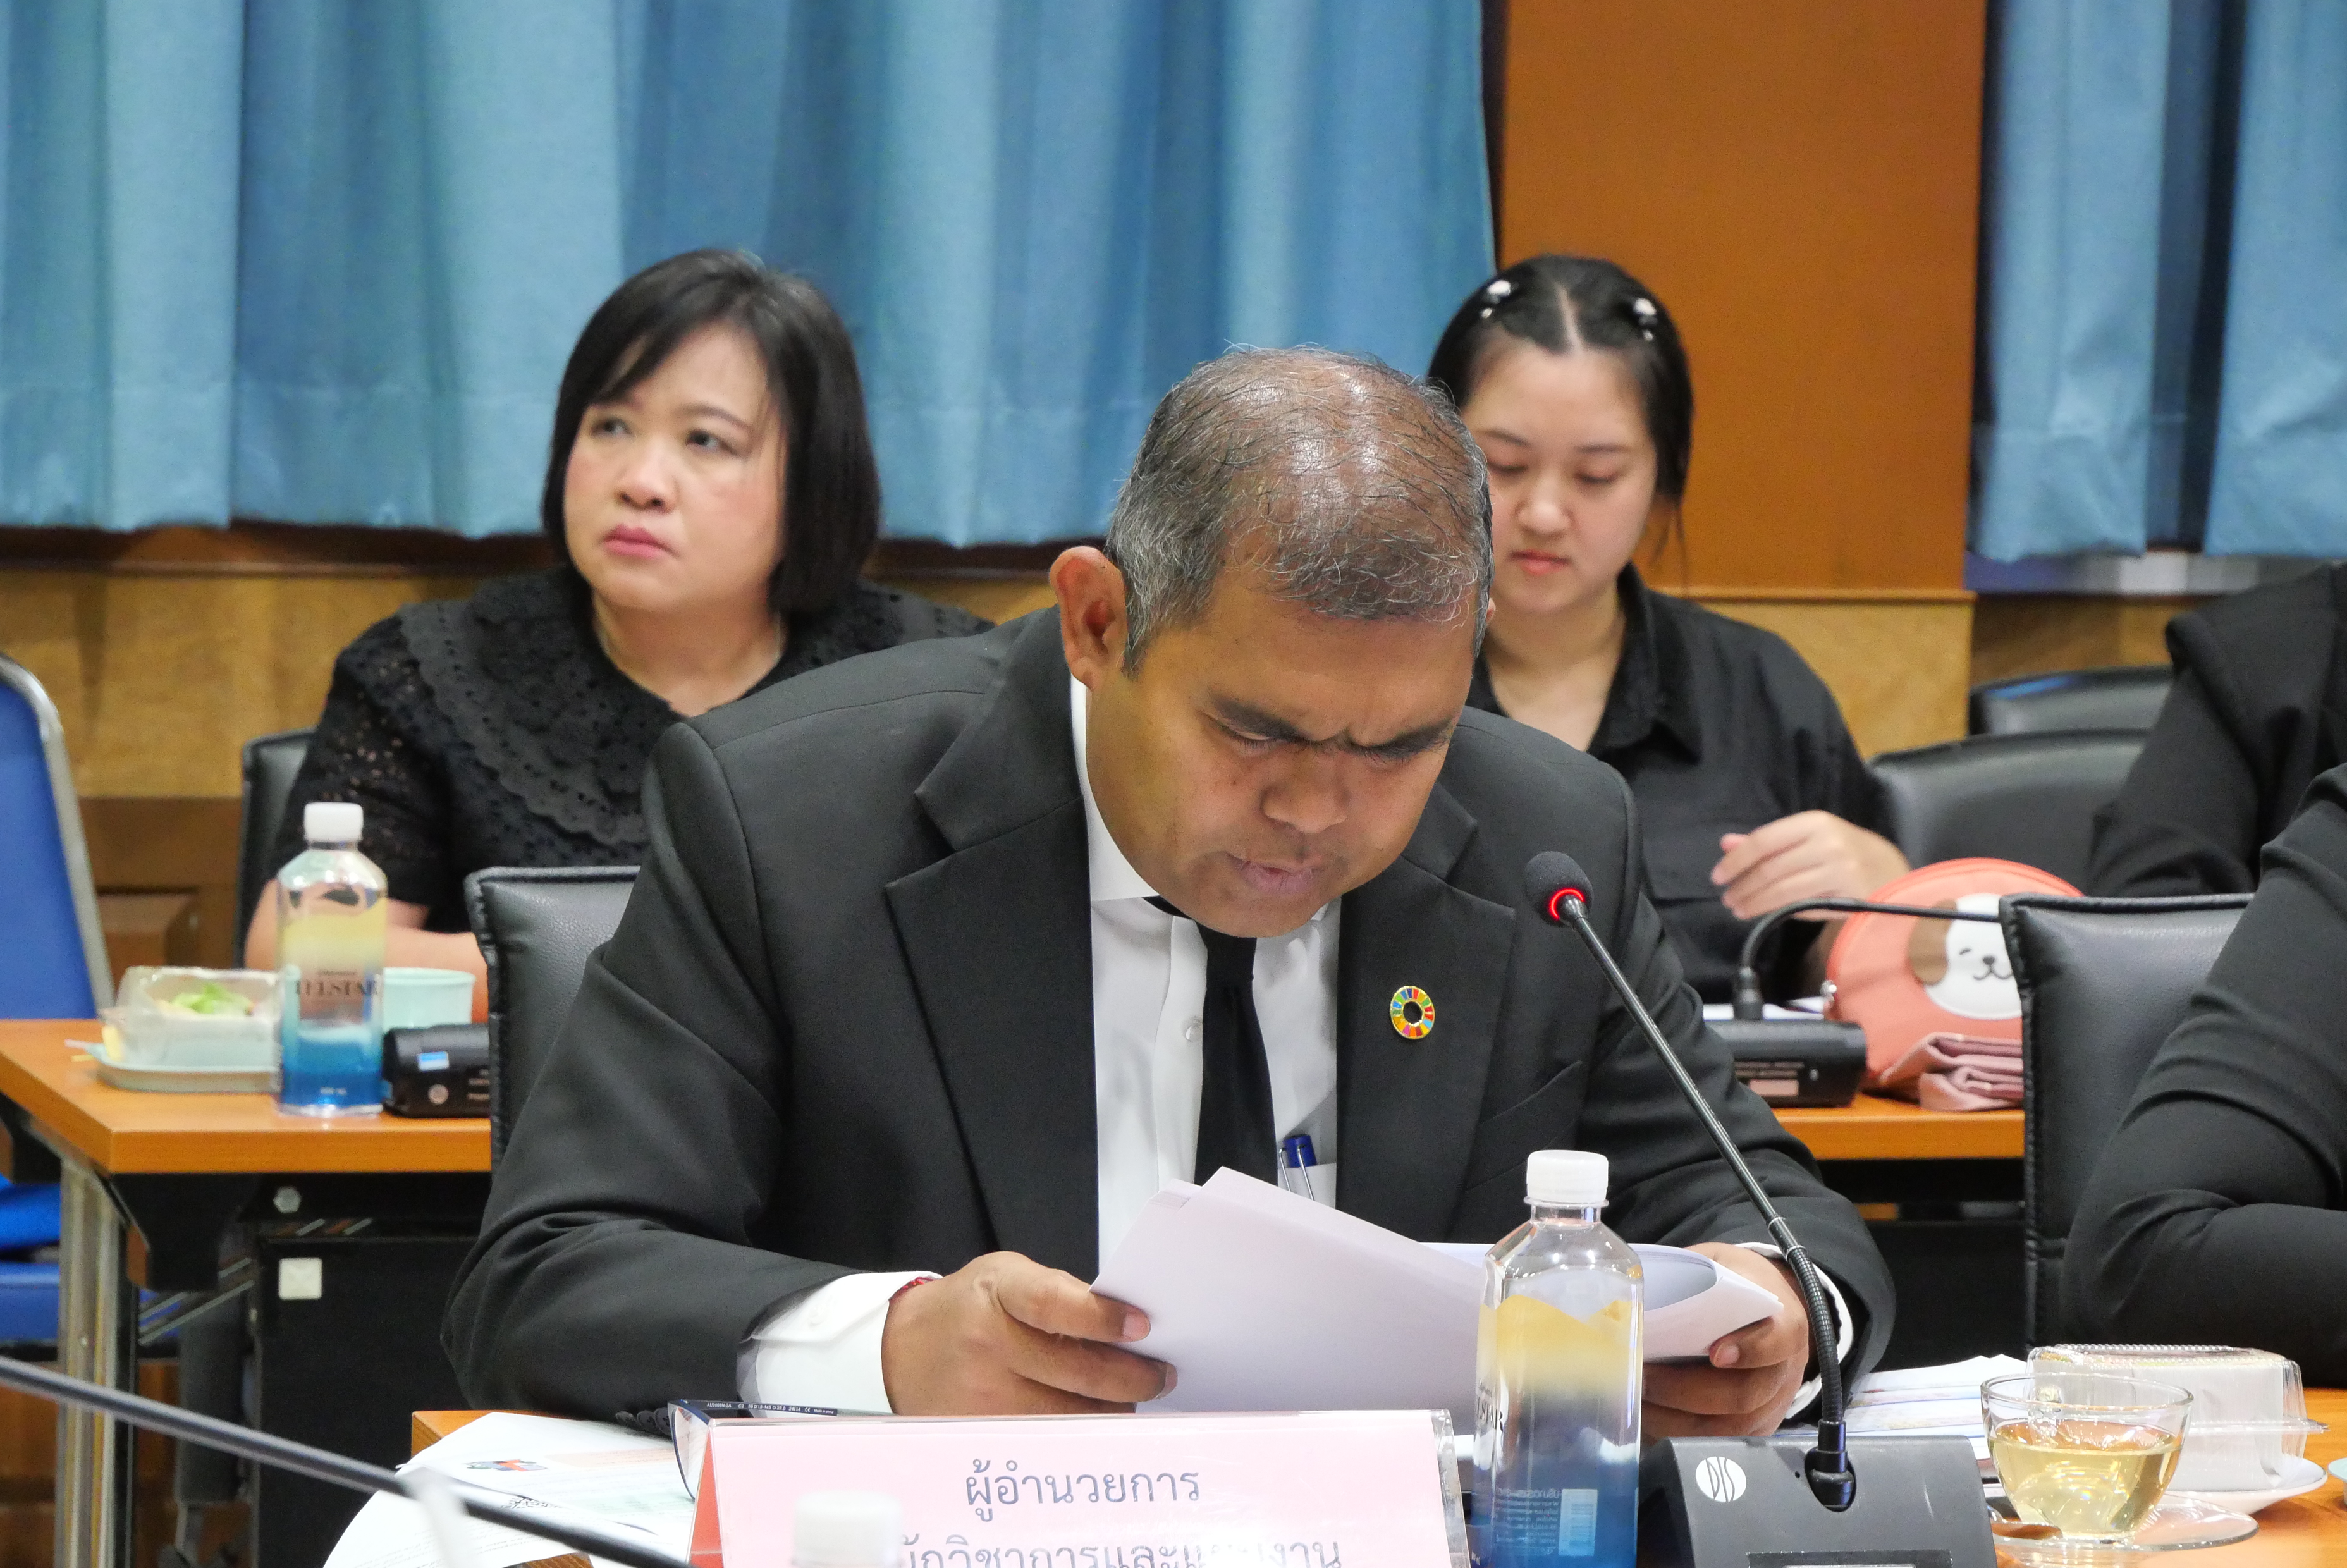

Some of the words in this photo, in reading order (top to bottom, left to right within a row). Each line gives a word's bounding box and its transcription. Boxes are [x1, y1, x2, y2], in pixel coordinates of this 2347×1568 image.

[966, 1459, 1200, 1522] ผู้อำนวยการ
